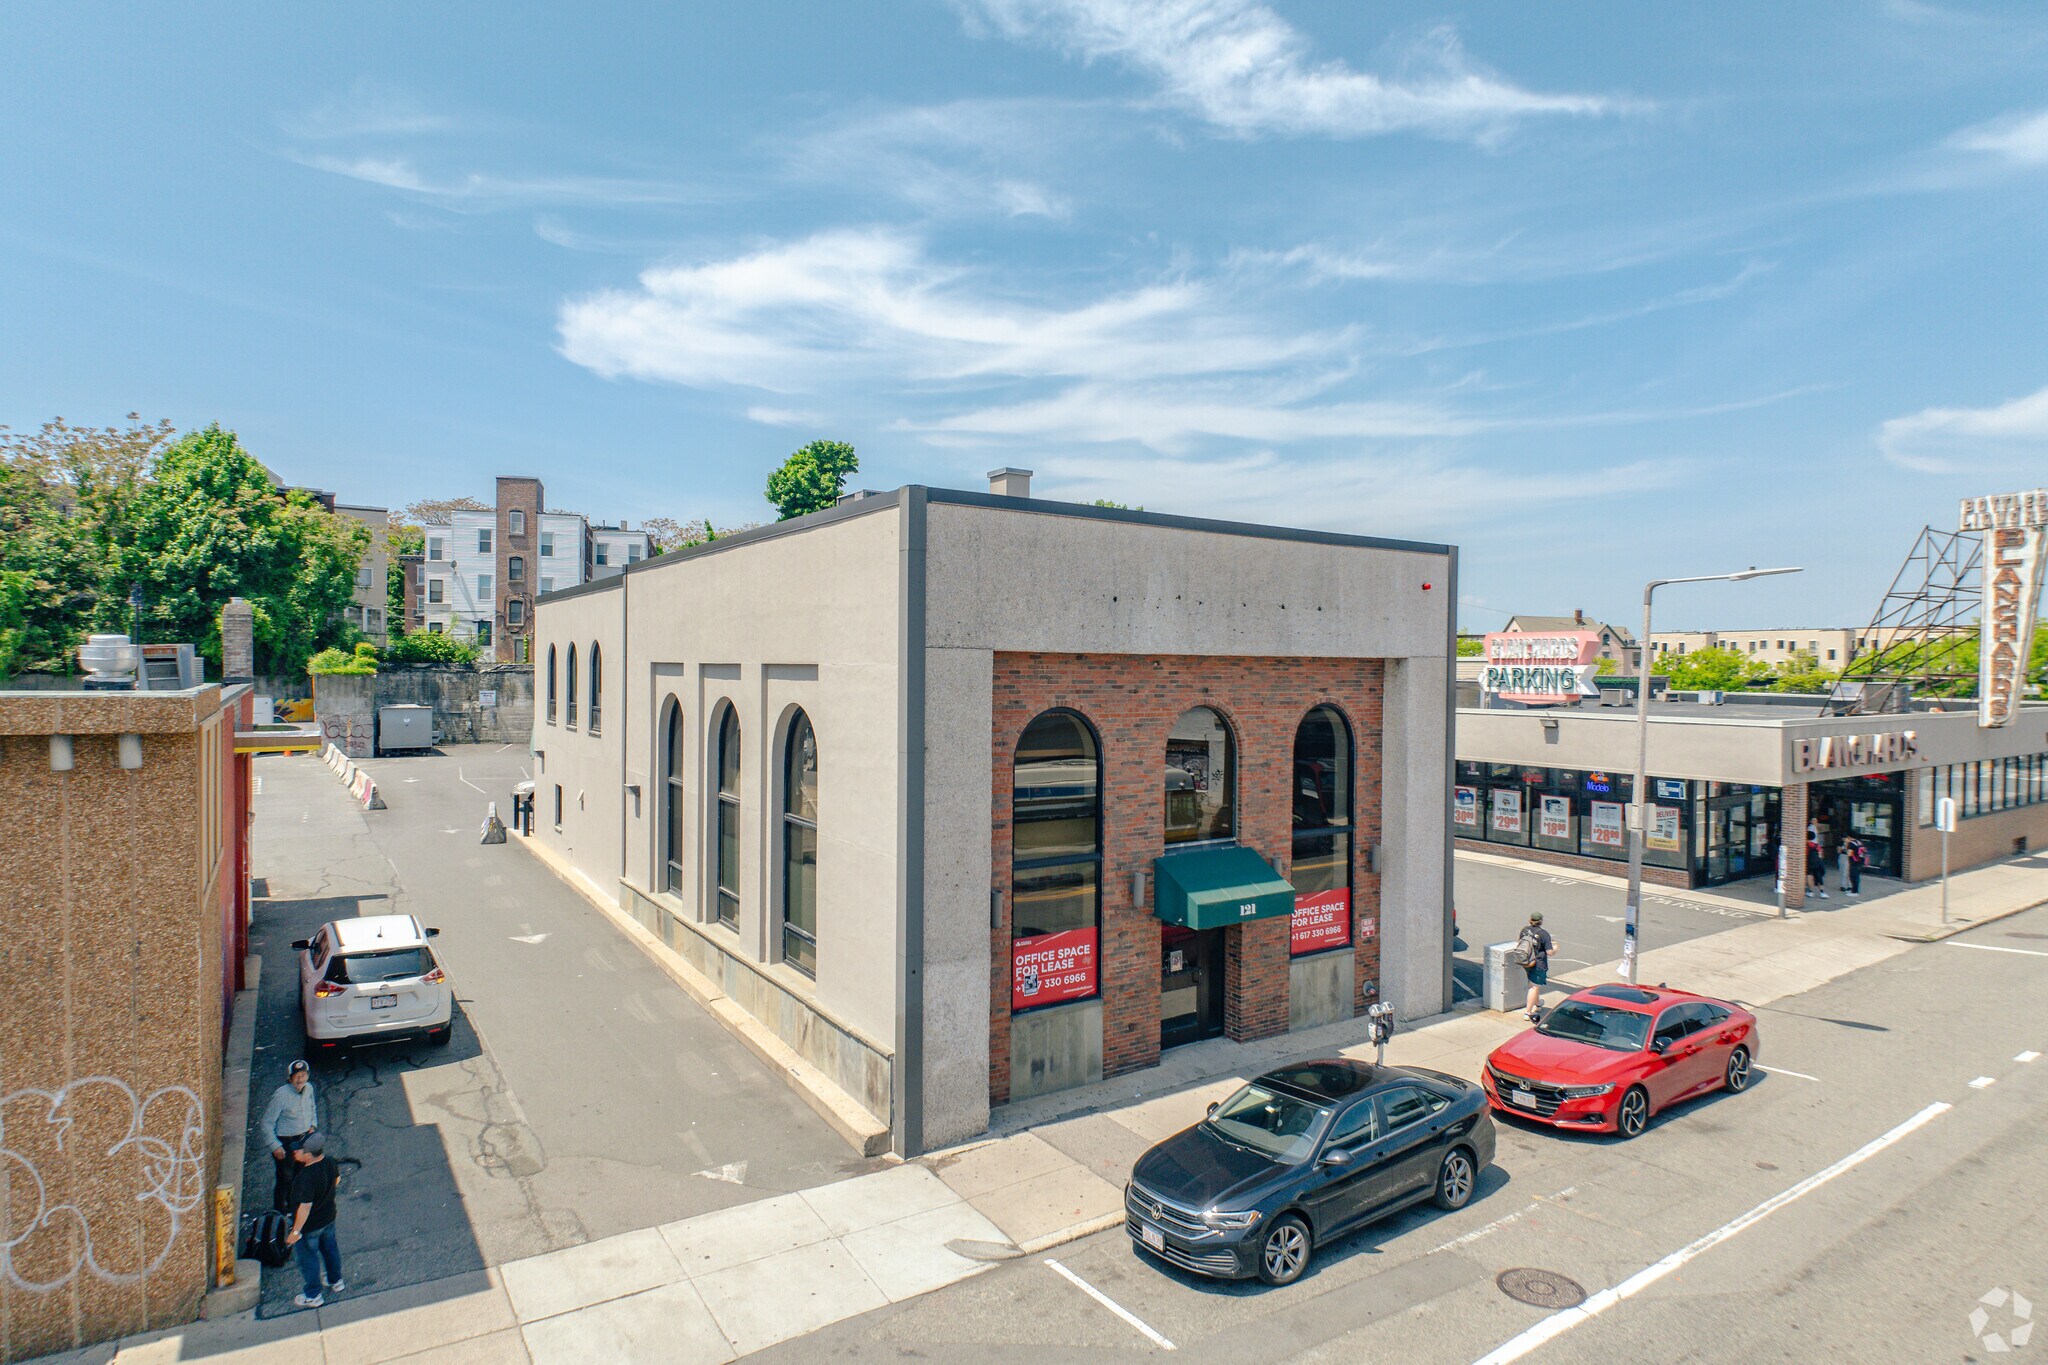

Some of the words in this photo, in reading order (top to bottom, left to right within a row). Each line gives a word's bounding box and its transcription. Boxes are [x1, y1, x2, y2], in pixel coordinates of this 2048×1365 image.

[1989, 528, 2025, 716] BLANCHARDS
[1486, 667, 1575, 690] PARKING
[1792, 730, 1917, 773] BLANCHARDS
[1586, 781, 1610, 793] Modelo
[1239, 903, 1256, 916] 121
[1291, 905, 1320, 918] OFFICE
[1321, 902, 1345, 914] SPACE
[1291, 918, 1309, 928] FOR
[1310, 913, 1334, 925] LEASE
[1291, 933, 1299, 941] +1
[1300, 930, 1310, 940] 617
[1312, 928, 1324, 938] 330
[1325, 925, 1342, 935] 6966
[1015, 950, 1055, 966] OFFICE
[1057, 944, 1091, 959] SPACE
[1015, 964, 1038, 978] FOR
[1041, 958, 1075, 973] LEASE
[1044, 977, 1062, 988] 330
[1063, 972, 1086, 985] 6966
